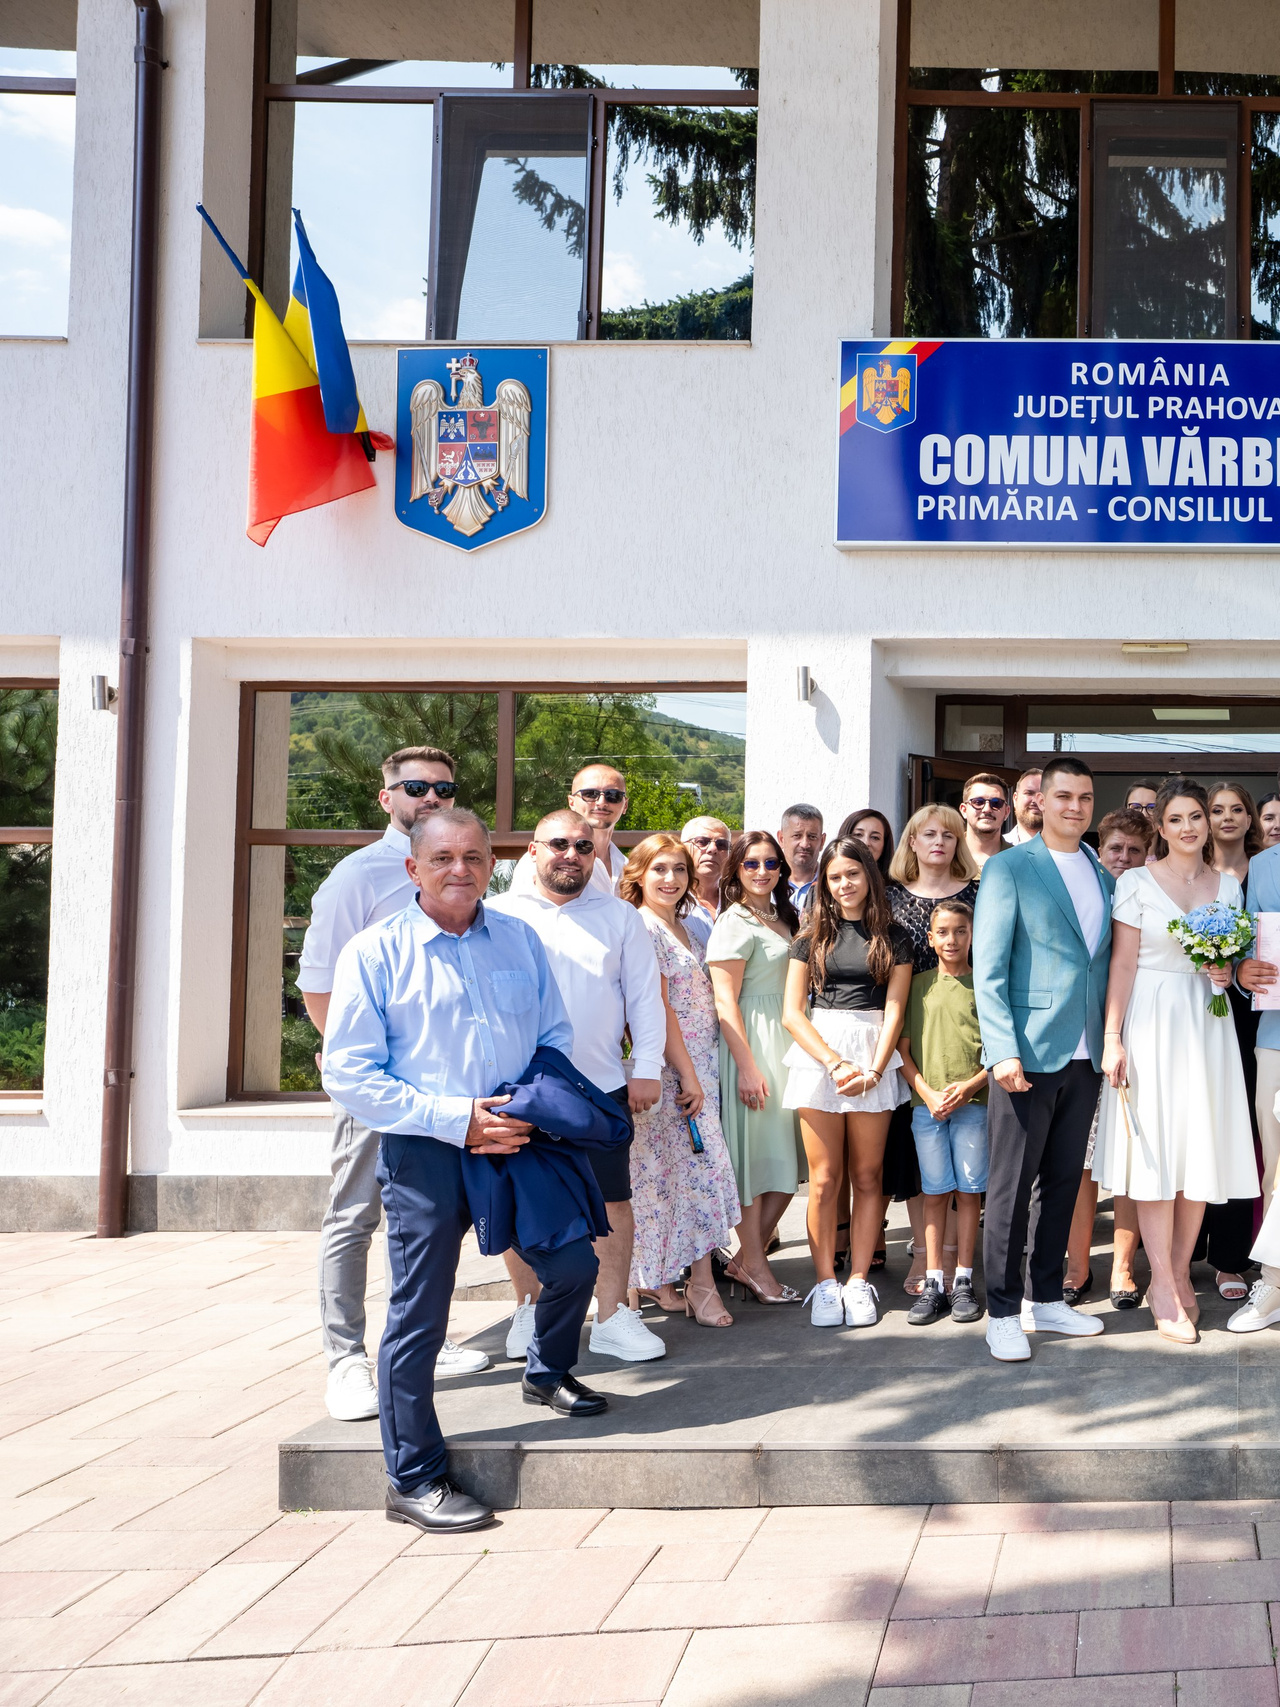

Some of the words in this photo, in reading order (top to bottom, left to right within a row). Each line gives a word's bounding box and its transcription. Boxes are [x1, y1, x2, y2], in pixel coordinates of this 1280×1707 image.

[1071, 356, 1230, 386] ROMÂNIA
[1013, 395, 1140, 424] JUDEȚUL
[919, 433, 1132, 487] COMUNA
[917, 488, 1079, 521] PRIMĂRIA
[1108, 496, 1273, 523] CONSILIUL
